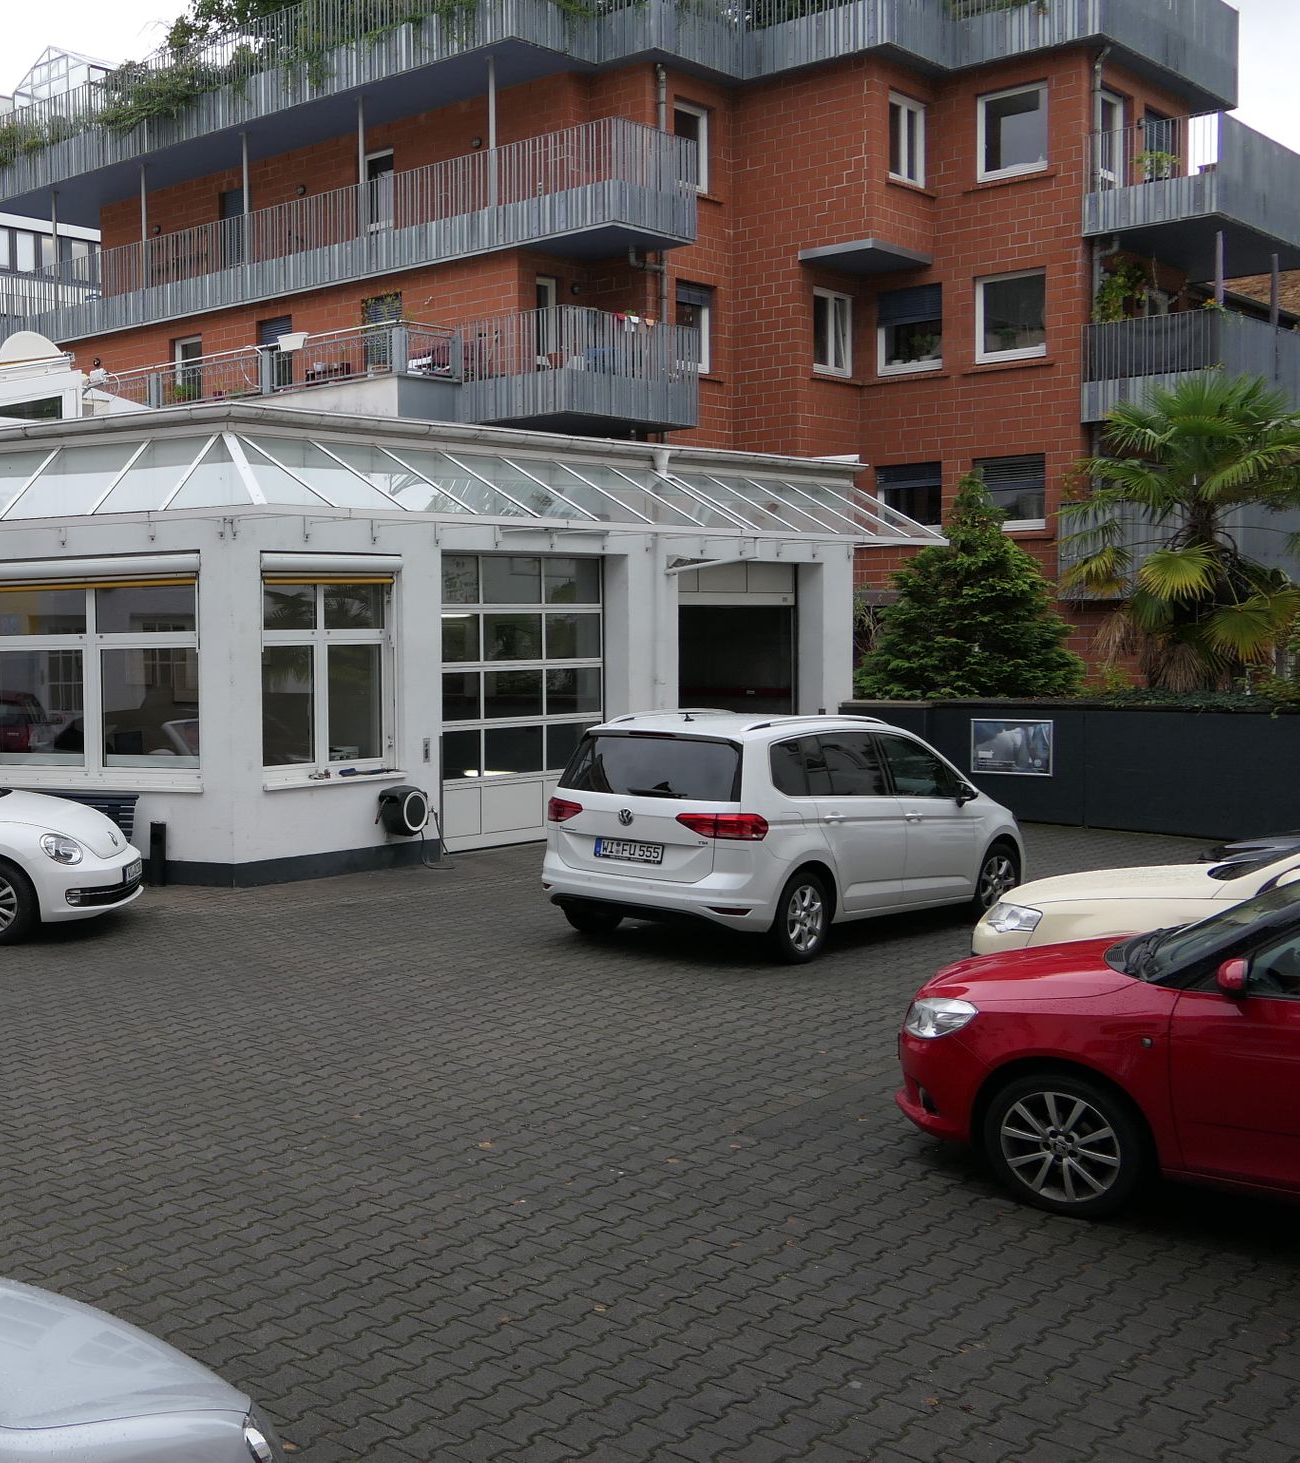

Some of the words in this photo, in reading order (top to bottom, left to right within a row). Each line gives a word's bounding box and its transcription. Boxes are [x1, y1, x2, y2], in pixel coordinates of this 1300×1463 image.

[602, 841, 615, 854] WI
[621, 843, 637, 856] FU
[638, 845, 661, 859] 555
